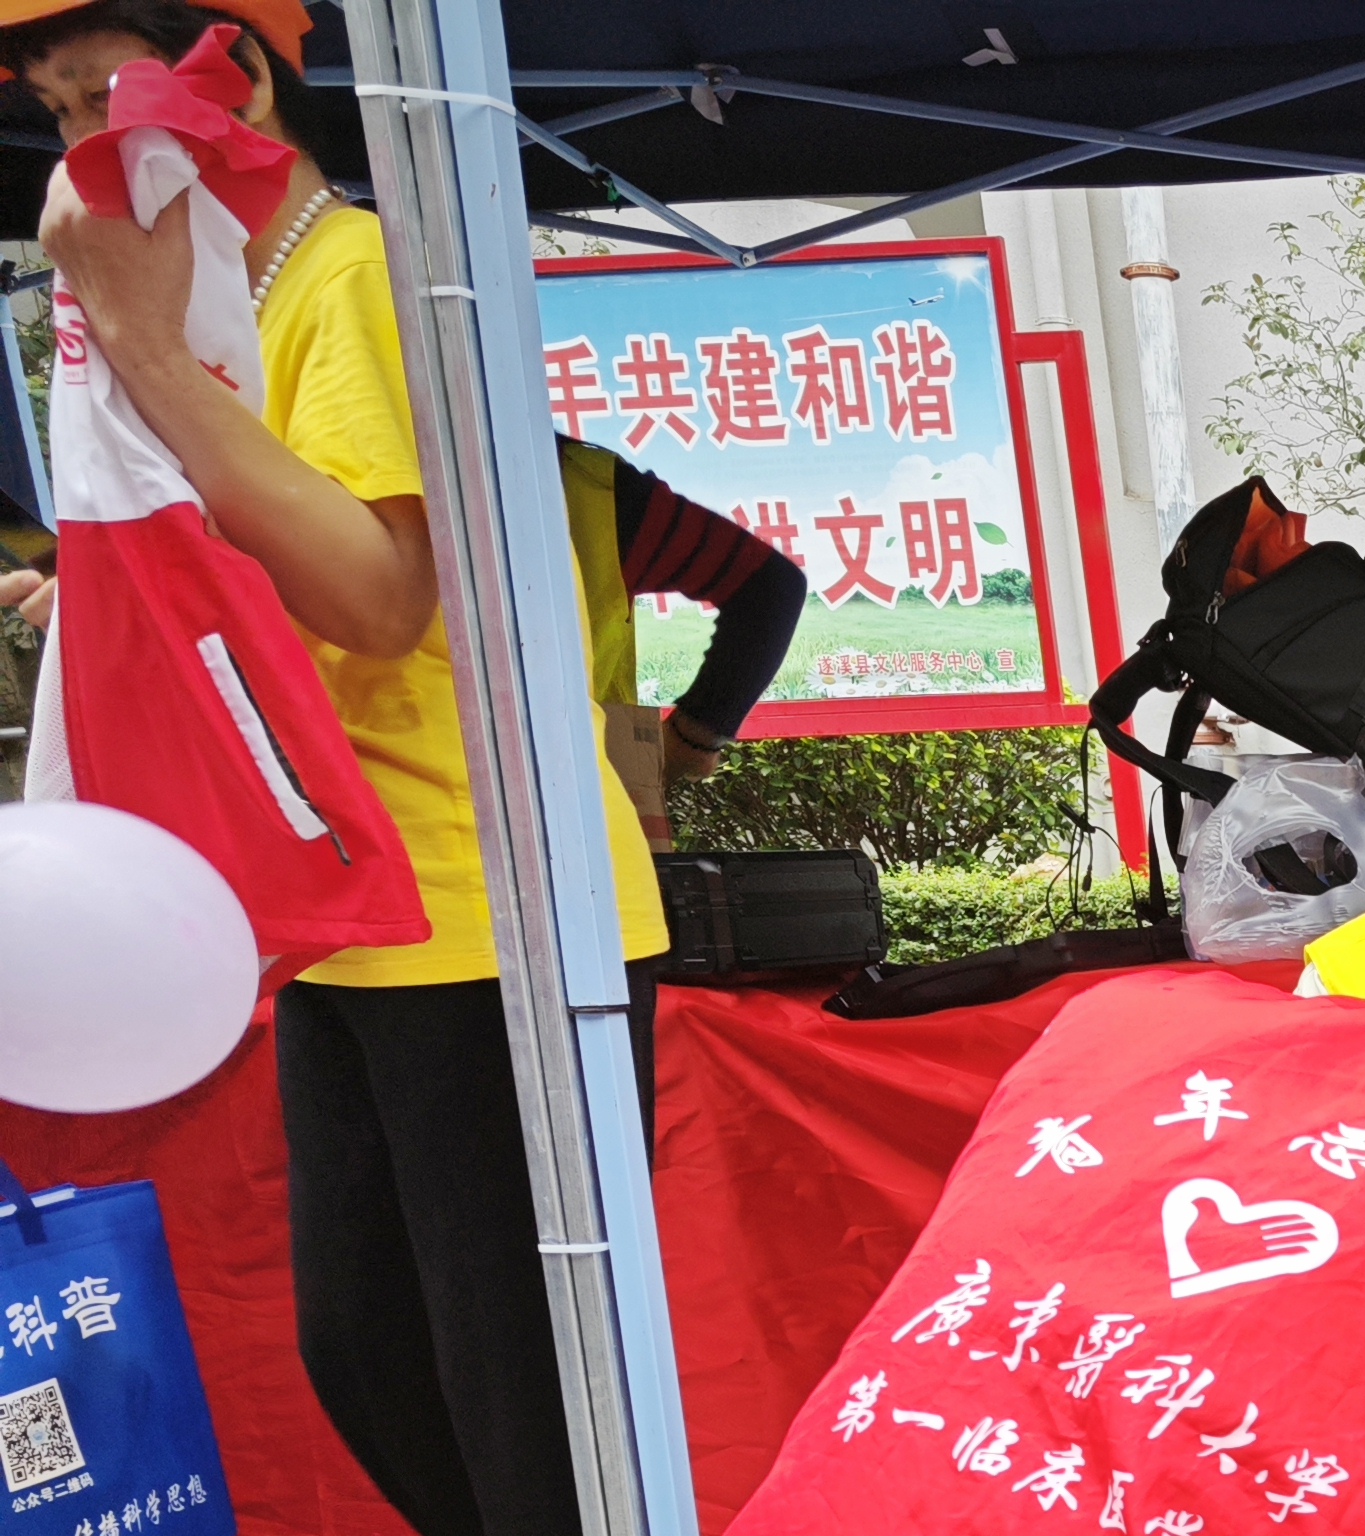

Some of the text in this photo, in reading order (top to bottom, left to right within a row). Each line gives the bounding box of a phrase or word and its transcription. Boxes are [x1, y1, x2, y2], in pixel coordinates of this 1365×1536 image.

[817, 650, 1016, 675] 遂溪县文化服务中心 宣
[0, 1275, 121, 1358] 科普
[11, 1471, 94, 1513] 公众号二维码
